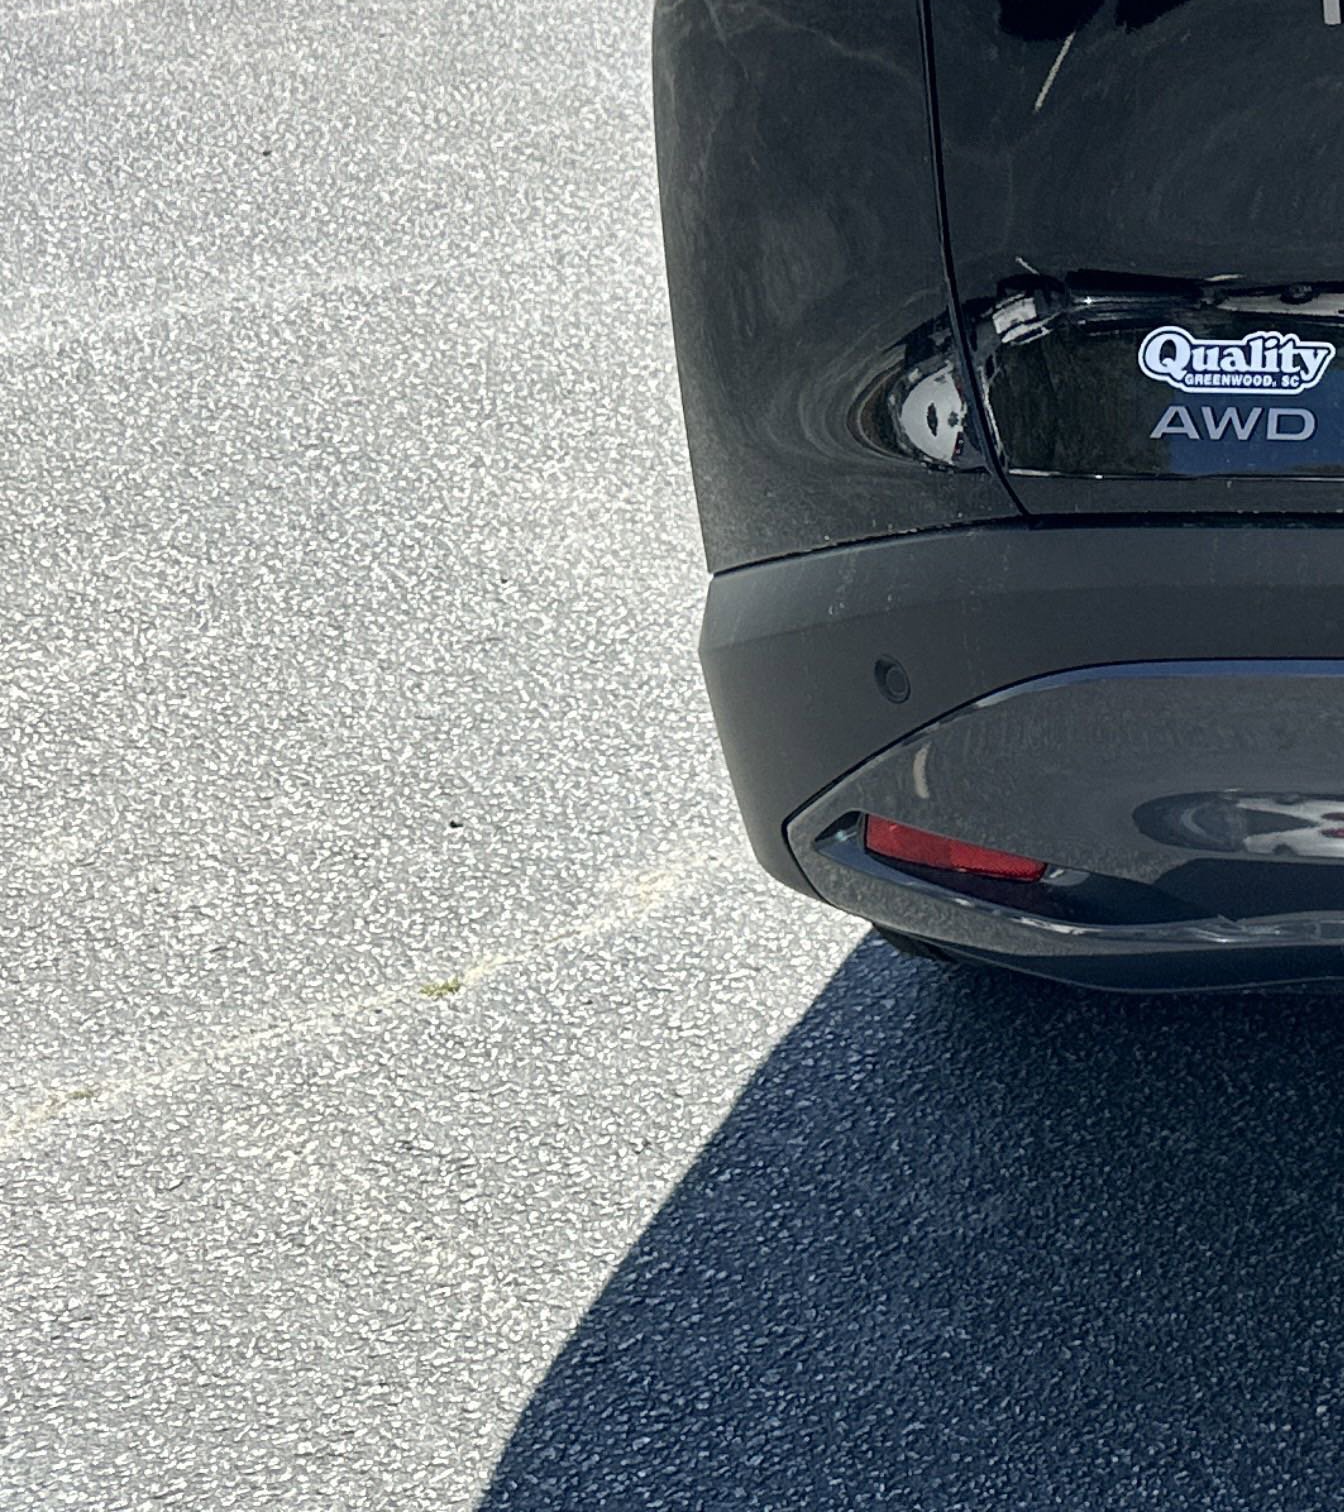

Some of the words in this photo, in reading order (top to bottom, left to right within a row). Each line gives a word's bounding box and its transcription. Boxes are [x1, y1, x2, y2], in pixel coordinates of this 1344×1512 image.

[1145, 334, 1330, 382] Quality
[1282, 373, 1300, 388] SC
[1150, 404, 1316, 441] AWD
